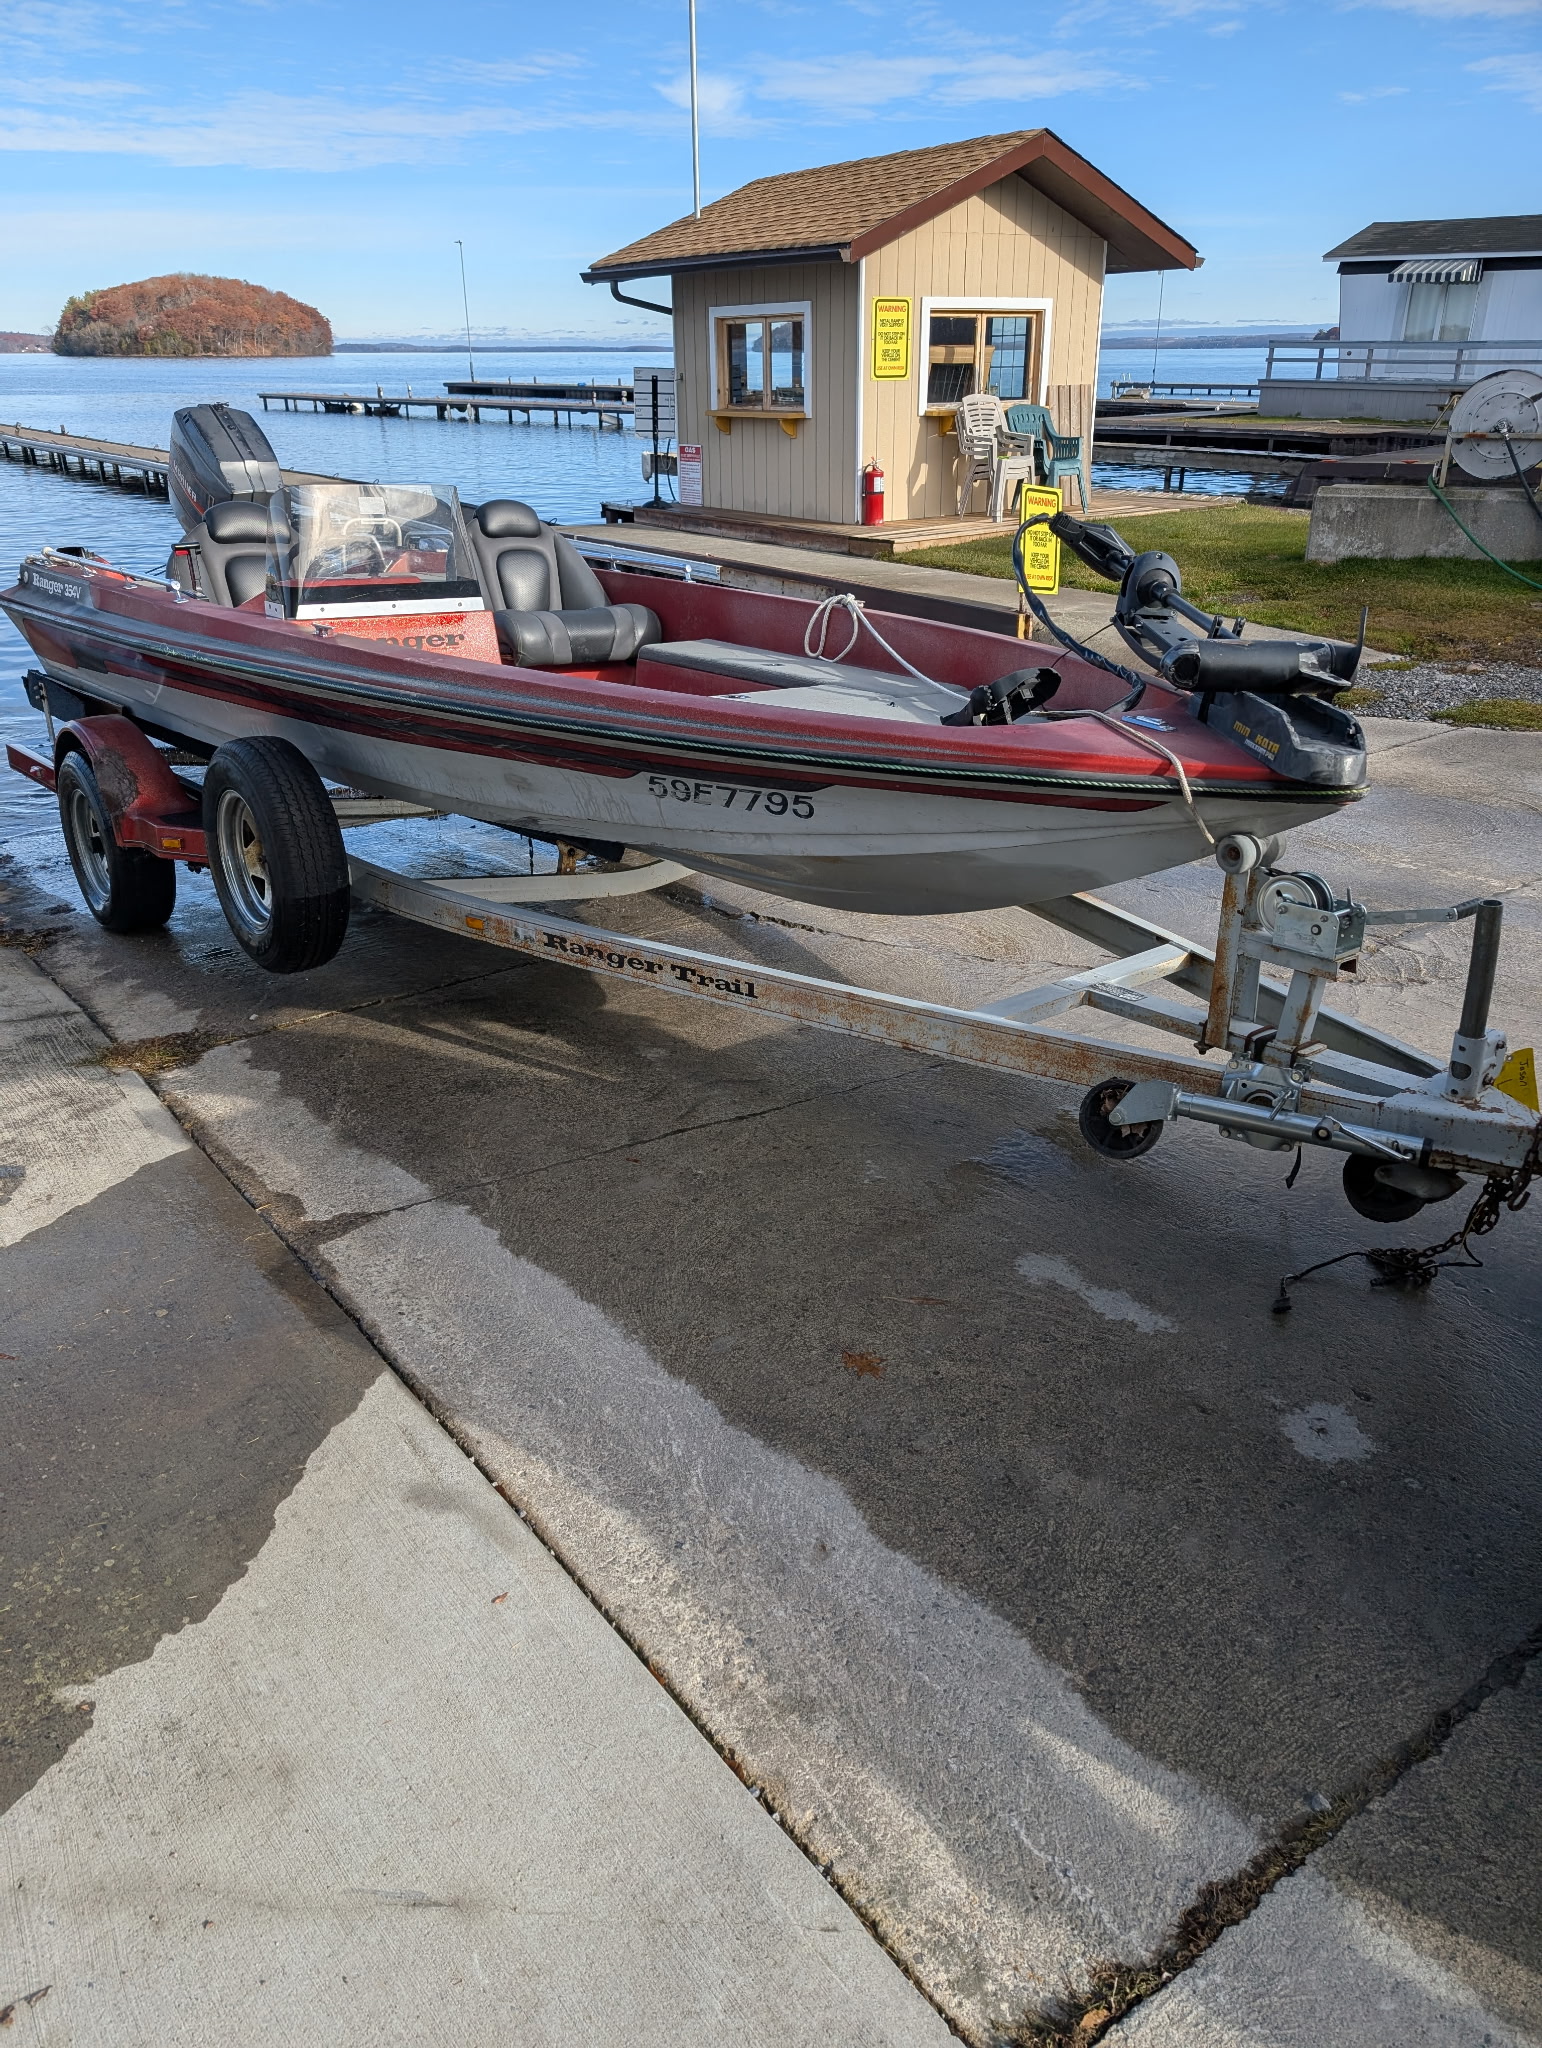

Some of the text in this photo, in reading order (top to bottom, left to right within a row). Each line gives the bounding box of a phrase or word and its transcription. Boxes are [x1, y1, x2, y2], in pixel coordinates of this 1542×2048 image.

[1028, 495, 1056, 508] WARNING
[33, 573, 81, 599] Ranger 354V
[542, 932, 758, 999] Ranger Trail
[1519, 1058, 1529, 1087] Jason
